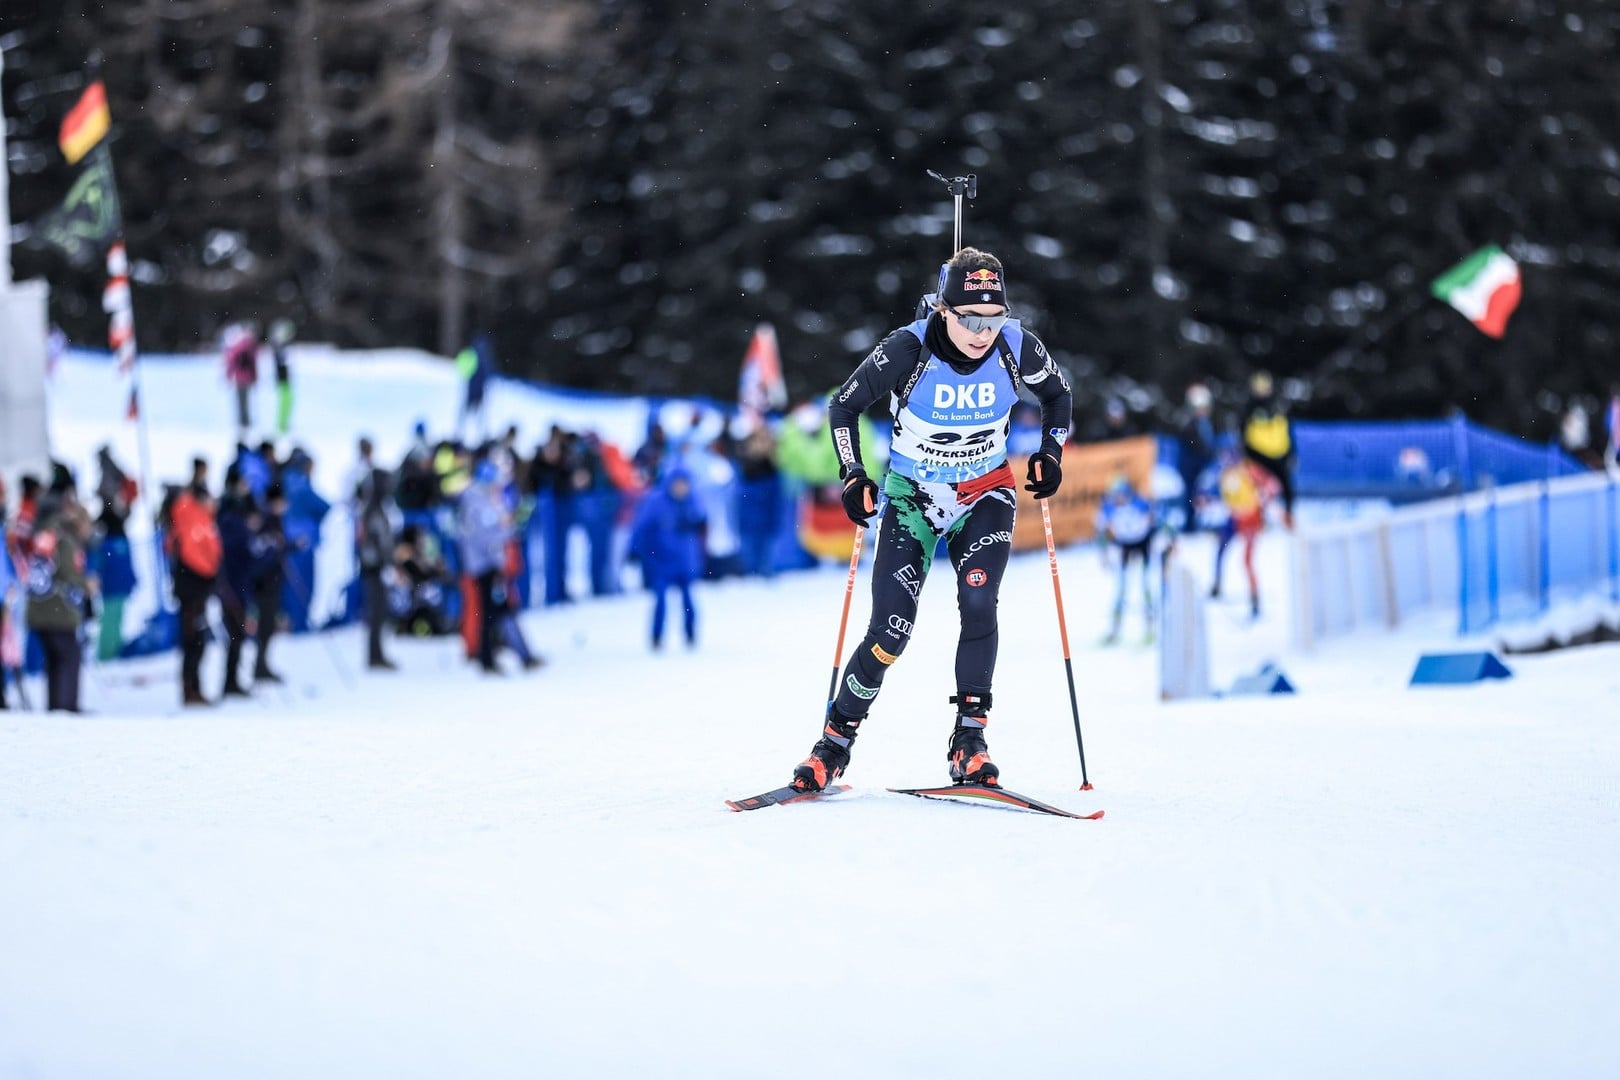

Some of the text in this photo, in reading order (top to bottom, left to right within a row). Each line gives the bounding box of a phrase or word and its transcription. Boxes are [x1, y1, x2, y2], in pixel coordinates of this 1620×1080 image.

[964, 281, 985, 291] Red
[933, 382, 996, 409] DKB
[931, 410, 995, 421] Das kann Bank
[916, 440, 995, 458] ANTERSELVA
